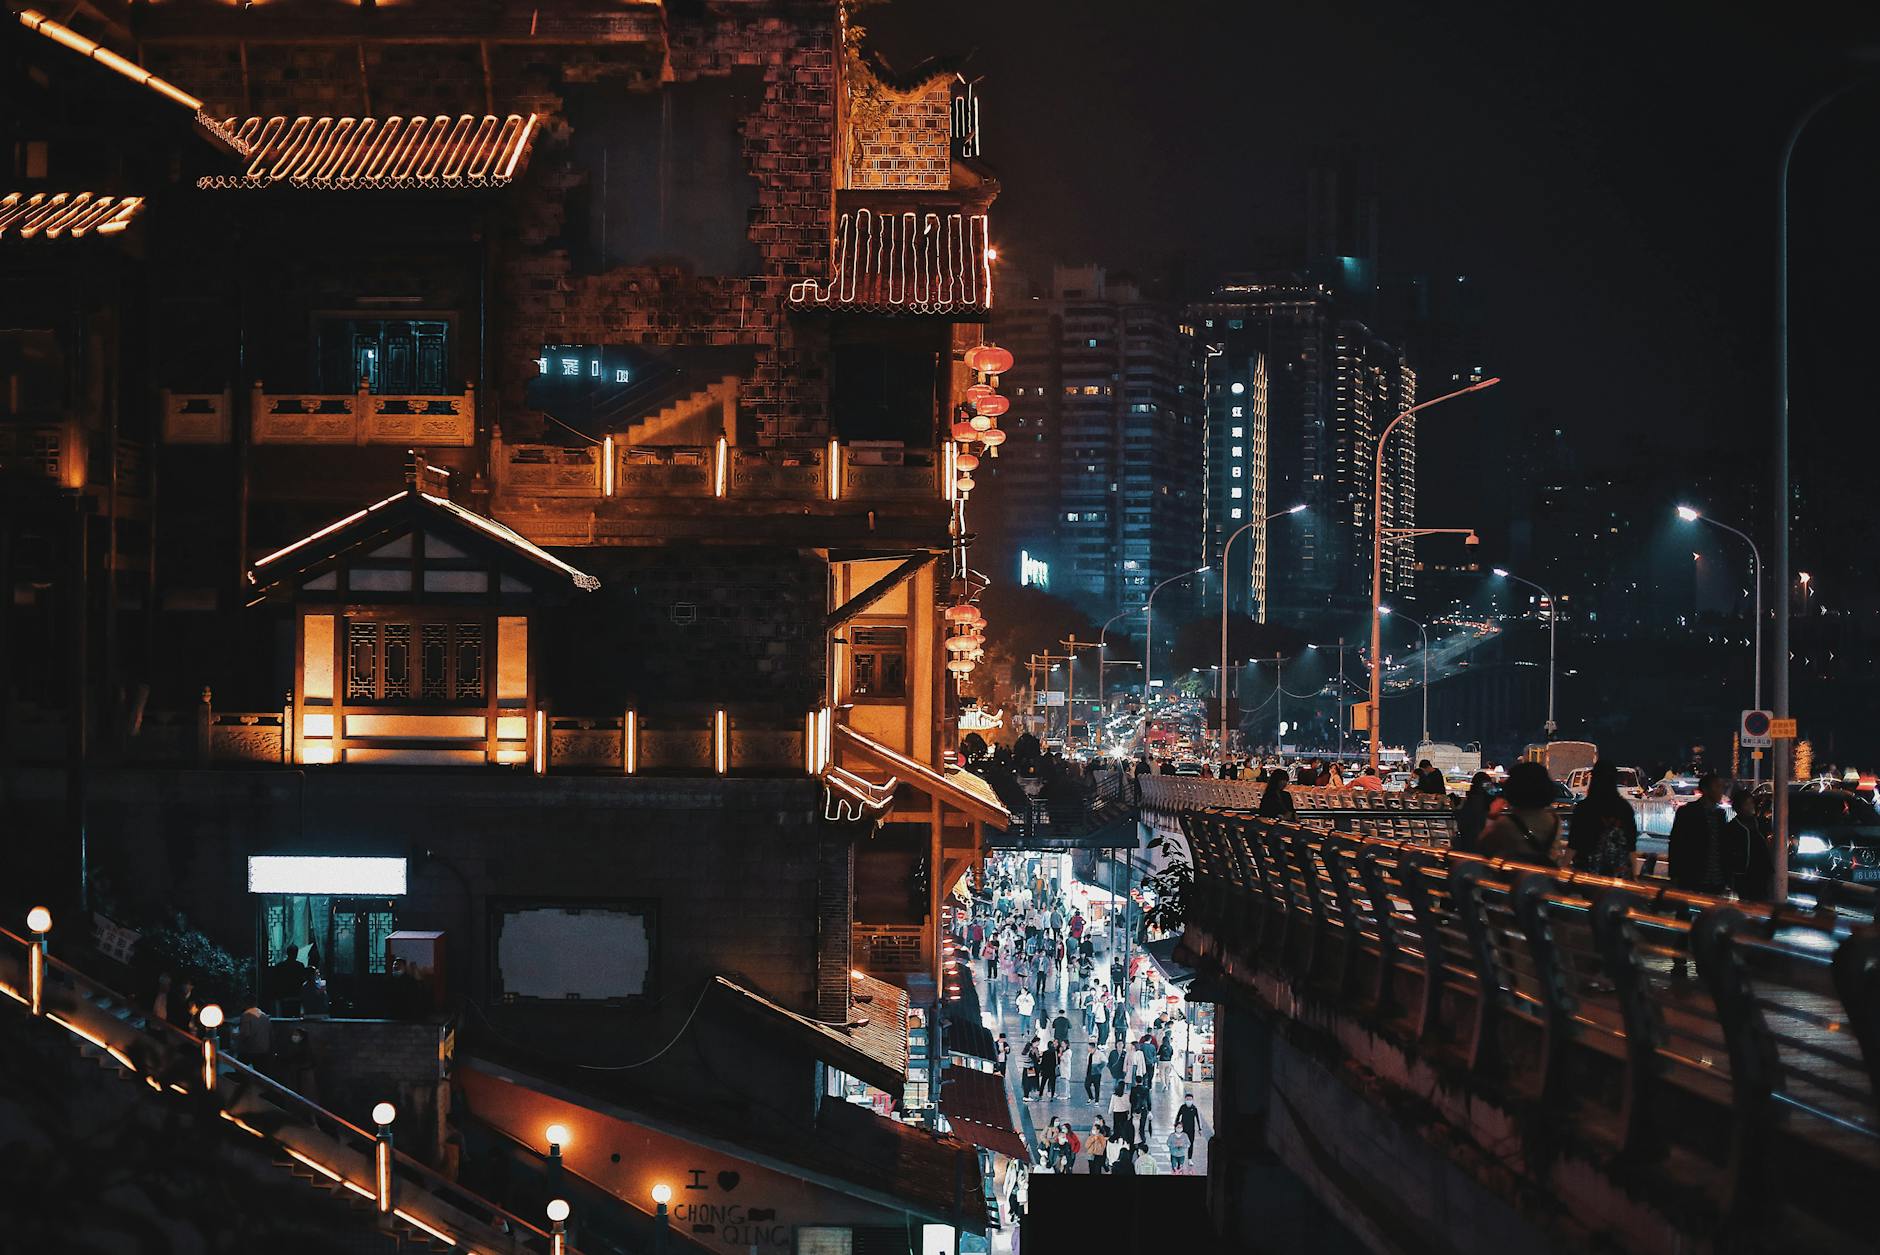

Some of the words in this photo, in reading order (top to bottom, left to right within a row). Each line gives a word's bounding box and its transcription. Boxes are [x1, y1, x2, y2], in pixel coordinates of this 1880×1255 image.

[686, 1169, 708, 1189] I
[674, 1204, 745, 1224] CHONG
[722, 1225, 789, 1247] QING
